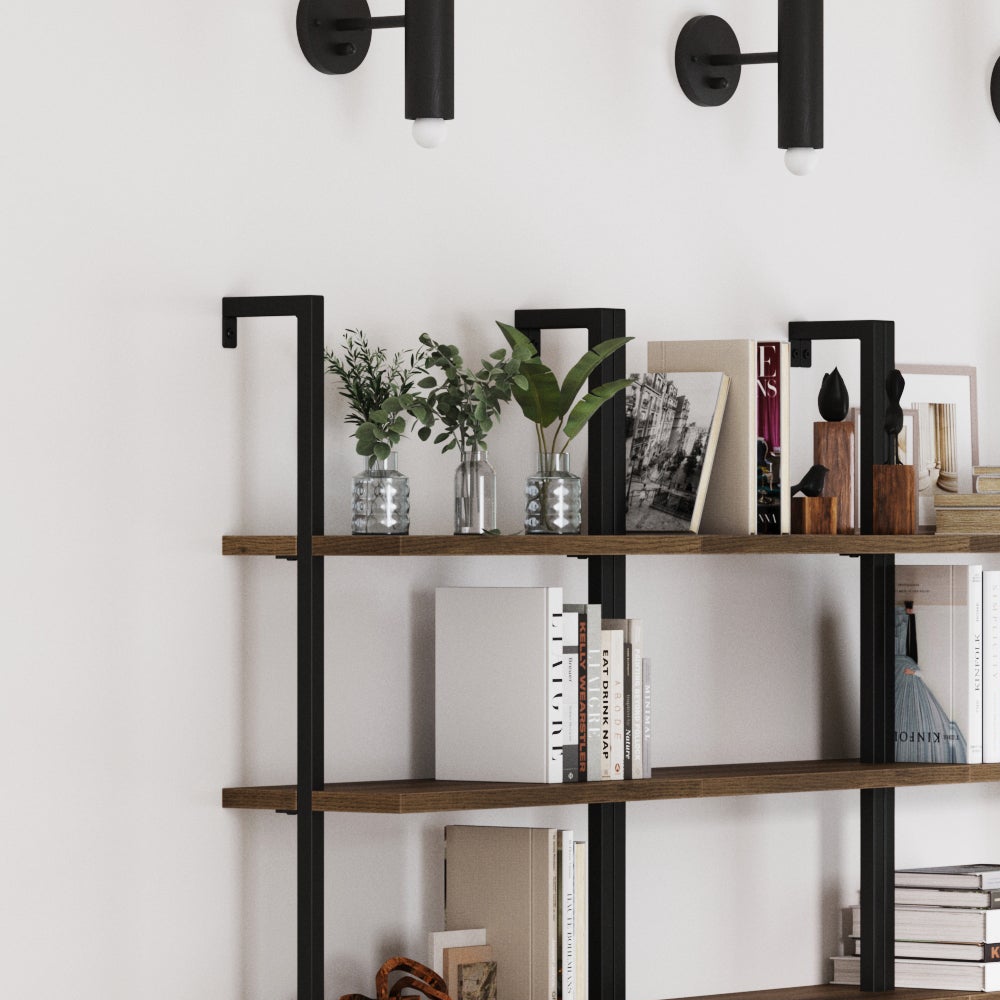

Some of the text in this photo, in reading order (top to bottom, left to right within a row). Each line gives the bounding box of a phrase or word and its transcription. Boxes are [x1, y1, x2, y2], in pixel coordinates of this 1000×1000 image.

[579, 621, 587, 773] KELLY WEARSTLER
[614, 680, 622, 740] ABODE
